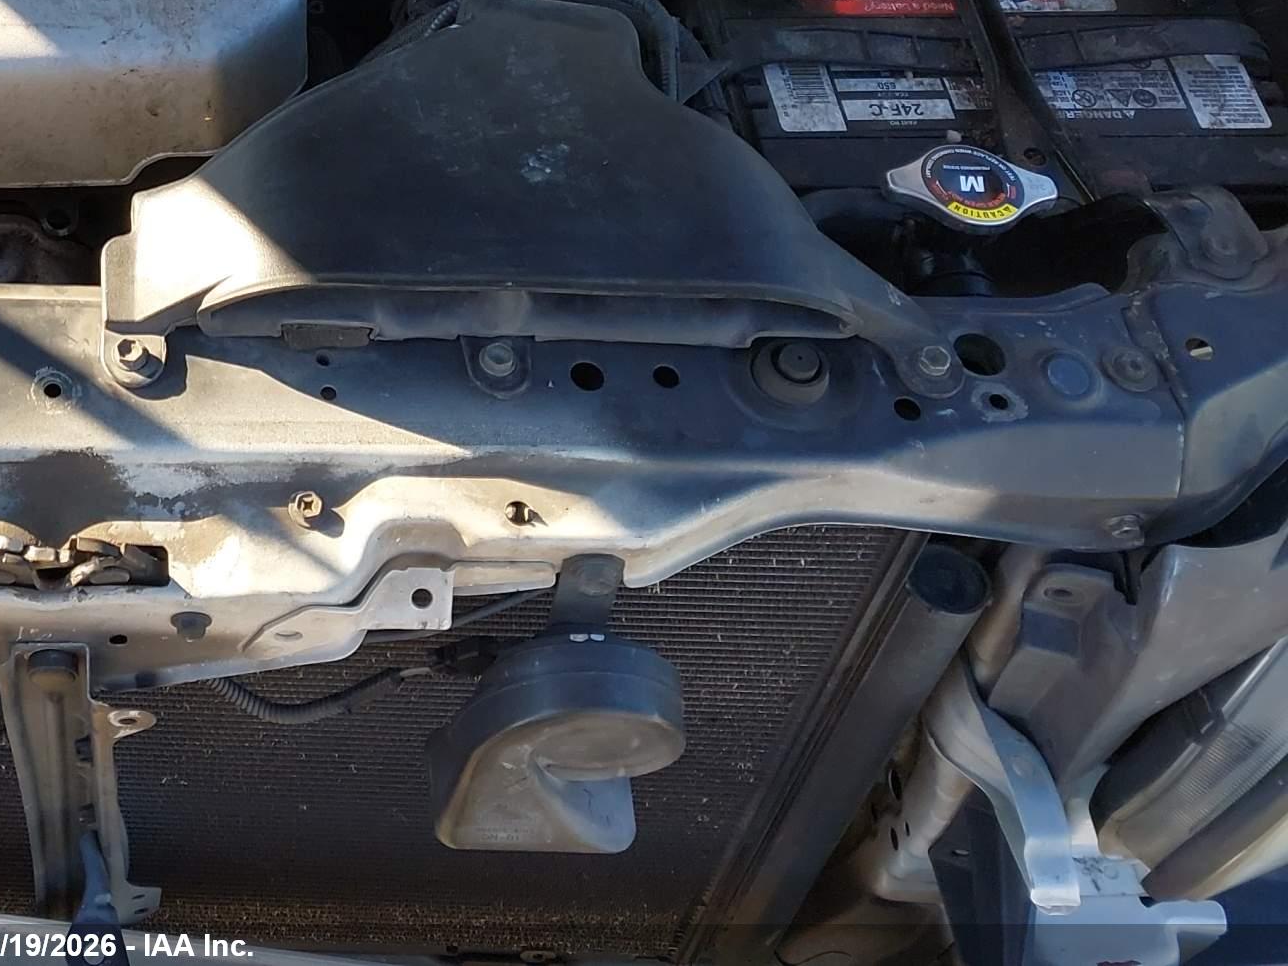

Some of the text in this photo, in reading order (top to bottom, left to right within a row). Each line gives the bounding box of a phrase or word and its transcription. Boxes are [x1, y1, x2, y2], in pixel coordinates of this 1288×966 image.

[878, 81, 897, 90] 650
[869, 103, 924, 116] 24F-C
[959, 175, 985, 193] M
[953, 204, 1005, 218] CAUTION
